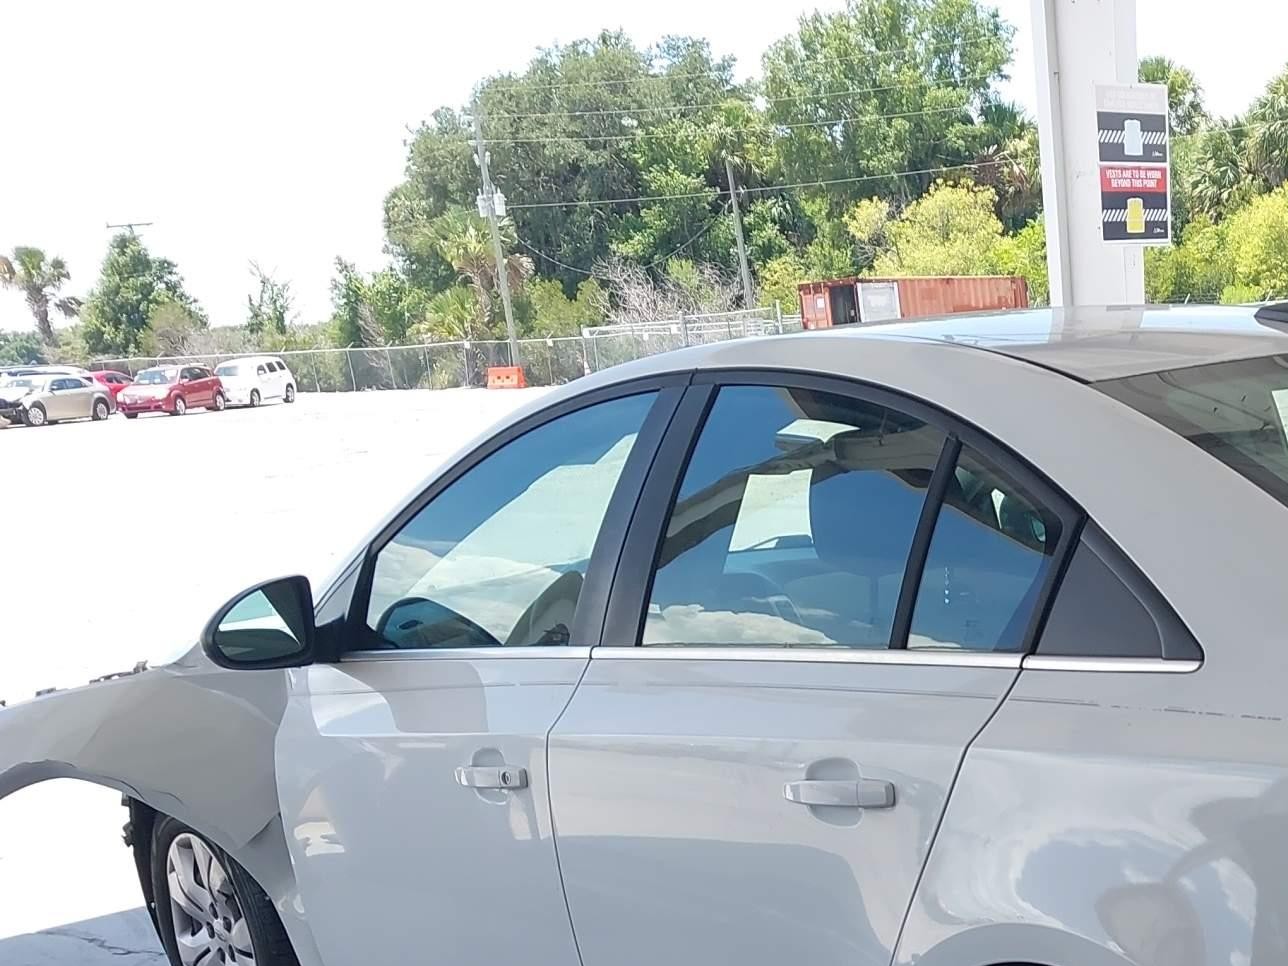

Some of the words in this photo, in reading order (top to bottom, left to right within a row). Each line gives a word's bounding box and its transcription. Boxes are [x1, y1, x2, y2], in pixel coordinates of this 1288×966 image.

[1105, 169, 1121, 179] VESTS
[1122, 169, 1132, 178] ARE
[1132, 169, 1139, 178] TO
[1139, 169, 1146, 178] BE
[1111, 178, 1131, 188] BEYOND
[1131, 179, 1143, 188] THIS
[1143, 179, 1158, 188] POINT
